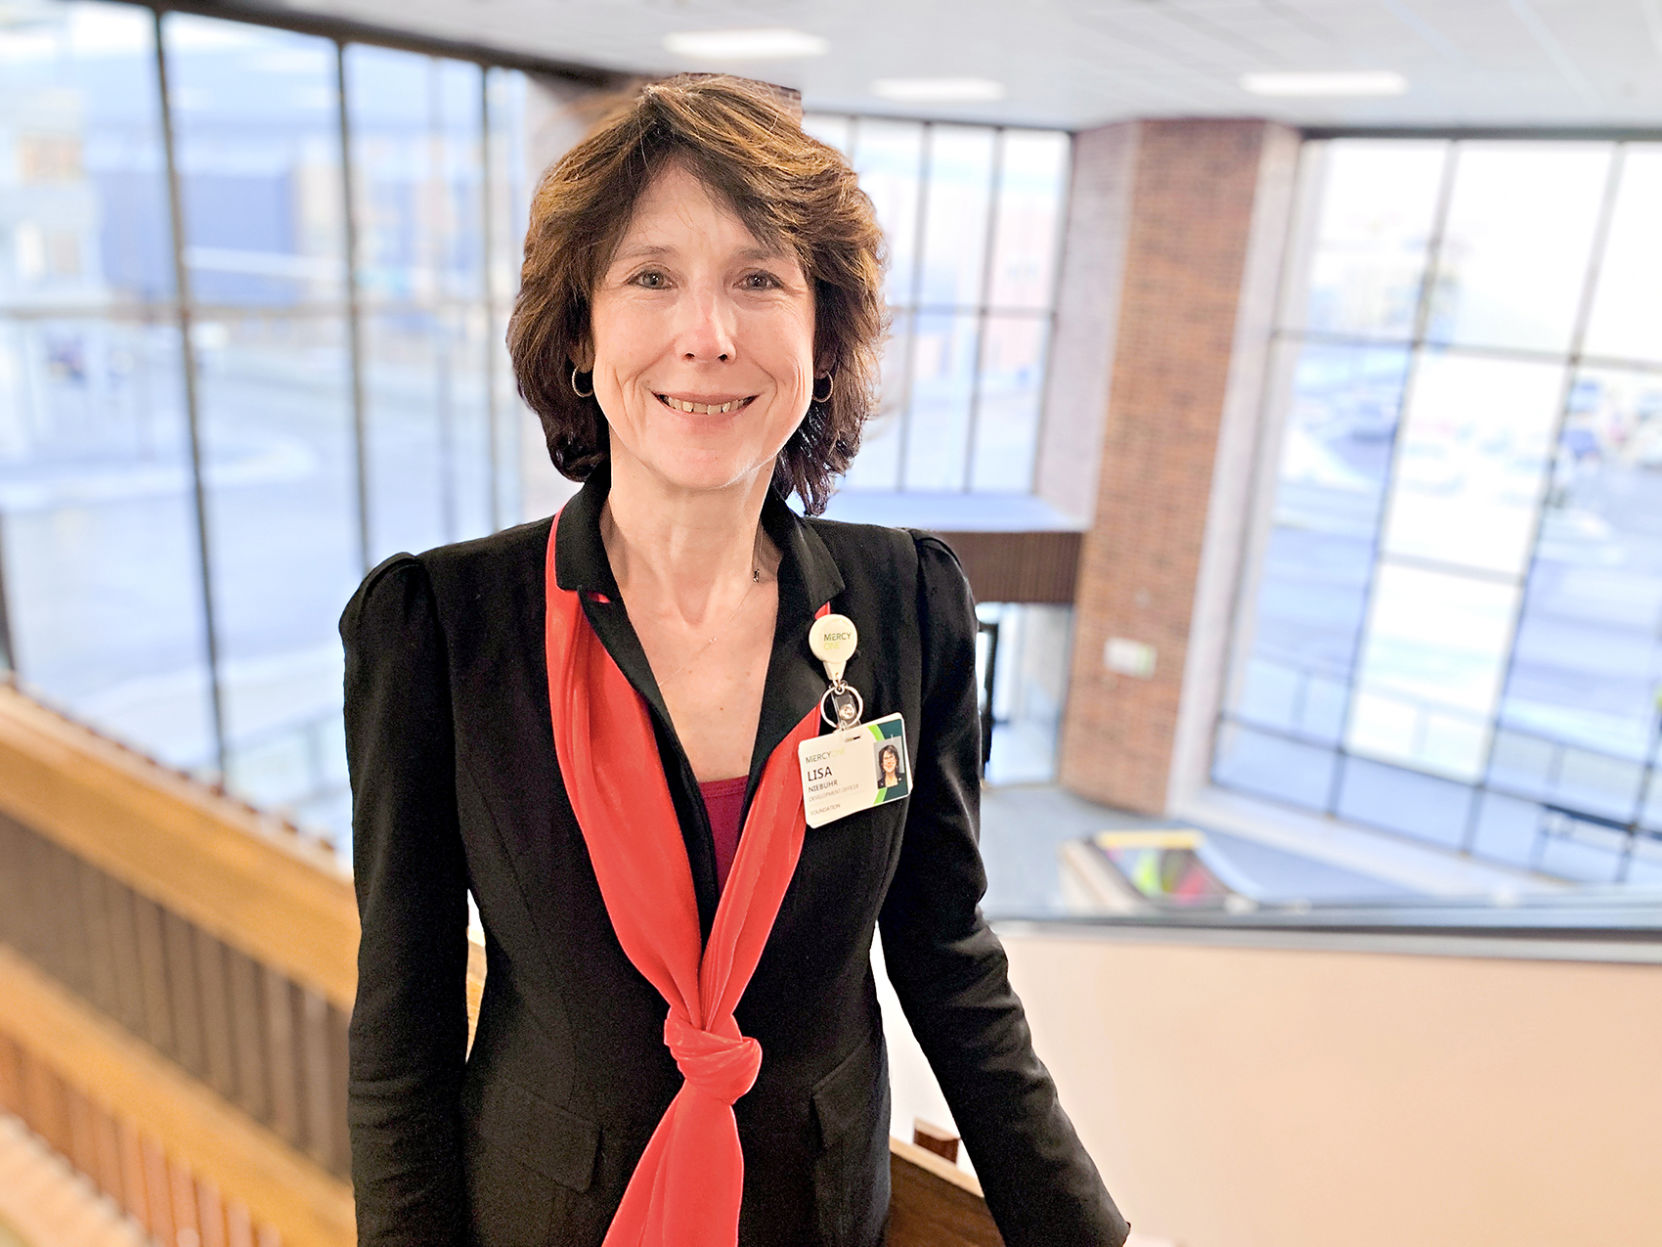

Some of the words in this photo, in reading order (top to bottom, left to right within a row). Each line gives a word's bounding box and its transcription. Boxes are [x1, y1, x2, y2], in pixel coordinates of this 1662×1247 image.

[824, 632, 851, 641] MERCY
[805, 748, 844, 764] MERCY
[807, 766, 833, 782] LISA
[808, 779, 838, 792] NIEBUHR
